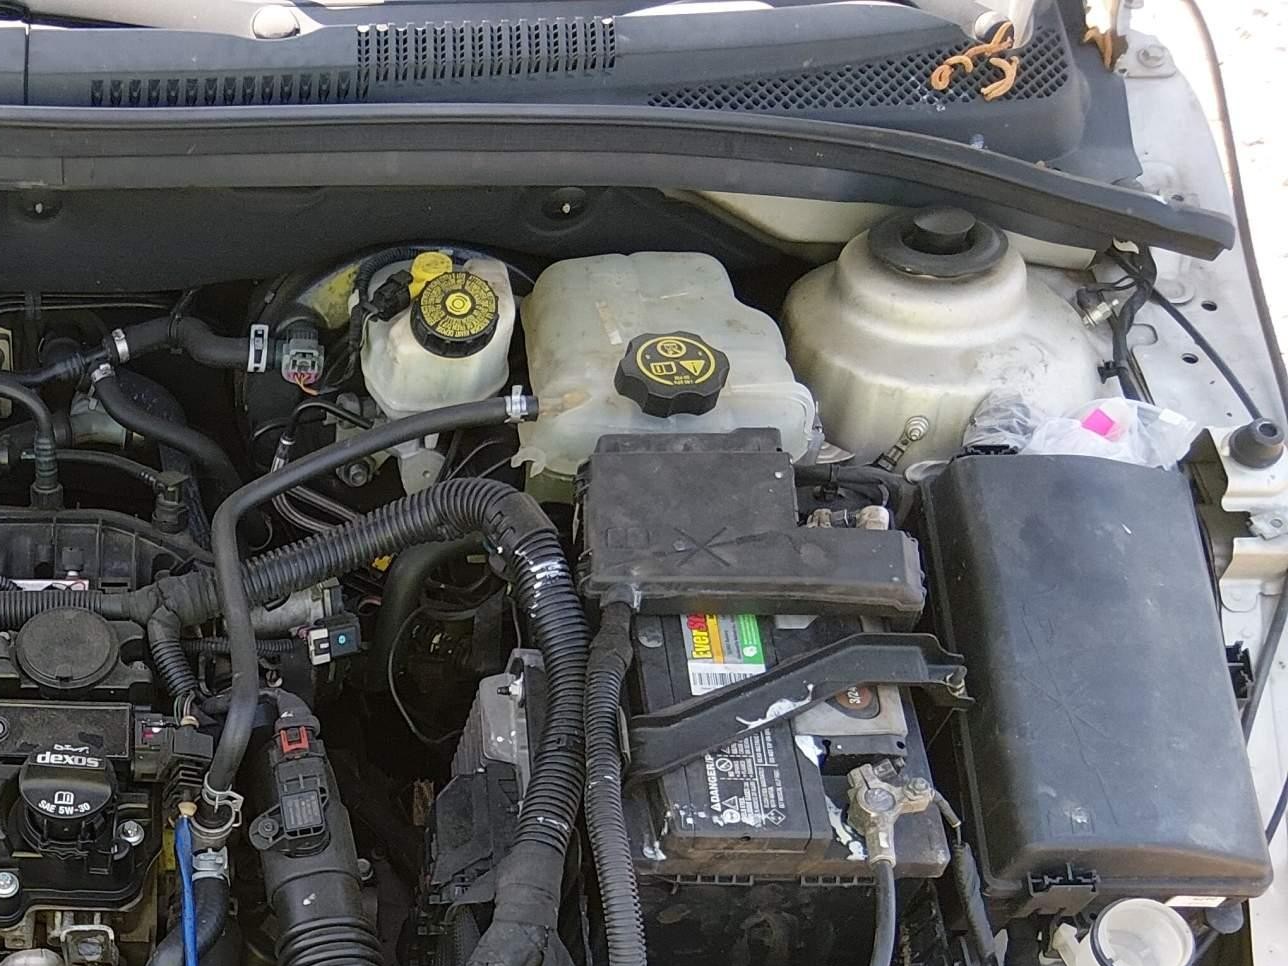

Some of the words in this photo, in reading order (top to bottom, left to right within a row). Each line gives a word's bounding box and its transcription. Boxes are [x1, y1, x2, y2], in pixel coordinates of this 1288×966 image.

[36, 751, 100, 768] dexos
[38, 799, 56, 813] SAE
[58, 802, 91, 815] 5W-30
